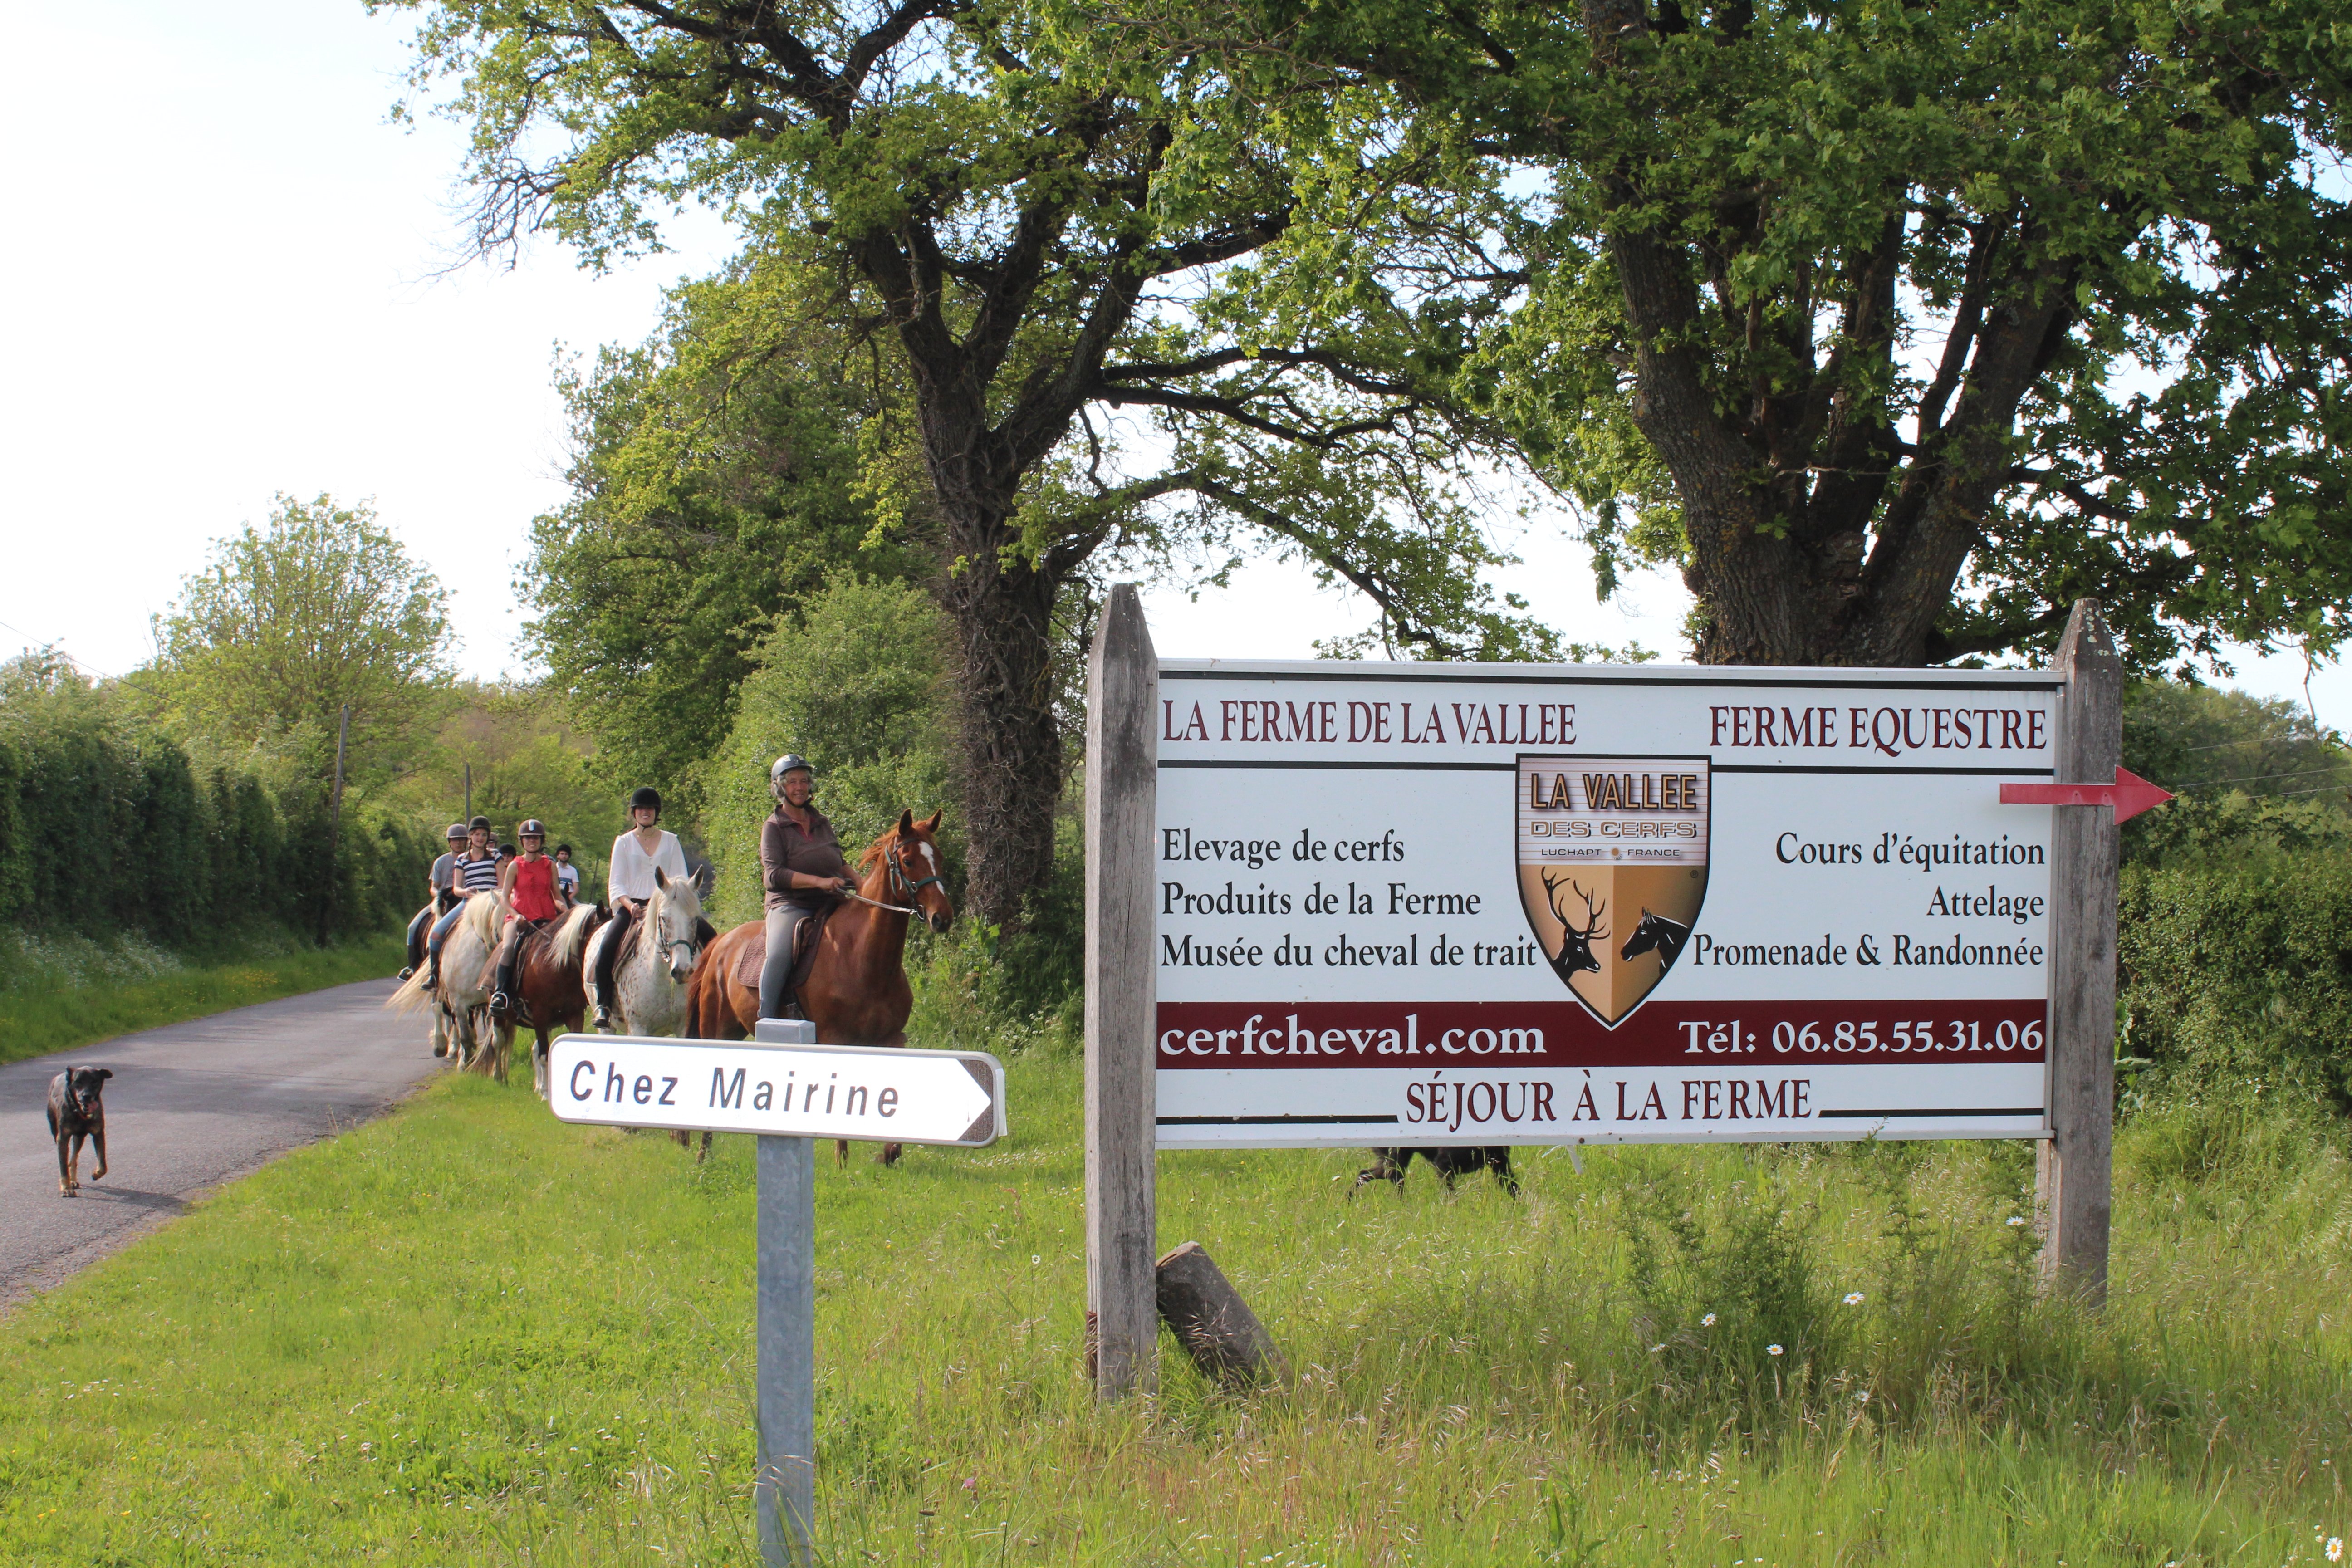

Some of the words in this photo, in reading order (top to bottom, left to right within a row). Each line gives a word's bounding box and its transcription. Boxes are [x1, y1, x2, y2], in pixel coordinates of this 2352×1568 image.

[1162, 699, 1210, 741] LA
[1220, 700, 1338, 743] FERME
[1347, 701, 1392, 743] DE
[1401, 702, 1447, 744] LA
[1451, 703, 1577, 745] VALLEE
[1709, 706, 1838, 747] FERME
[1848, 707, 2047, 757] EQUESTRE
[1531, 773, 1571, 809] LA
[1583, 774, 1697, 810] VALLEE
[1162, 828, 1281, 870] Elevage
[1292, 828, 1327, 862] de
[1334, 829, 1405, 862] cerfs
[1530, 821, 1591, 838] DES
[1600, 821, 1697, 838] CERFS
[1776, 832, 1862, 864] Cours
[1161, 881, 1291, 915] Produits
[1304, 882, 1338, 915] de
[1348, 882, 1374, 915] la
[1387, 882, 1481, 915] Ferme
[1926, 884, 2044, 925] Attelage
[1161, 934, 1263, 967] Musée
[1274, 933, 1313, 966] du
[1324, 933, 1418, 966] cheval
[1430, 933, 1464, 966] de
[1473, 934, 1537, 966] trait
[1693, 933, 1847, 965] Promenade
[1856, 934, 1881, 966] &
[1893, 933, 2043, 965] Randonnée
[1160, 1014, 1547, 1055] cerfcheval.com
[1678, 1019, 1756, 1053] Tél:
[1772, 1019, 2043, 1053] 06.85.55.31.06
[570, 1060, 678, 1106] Chez
[709, 1067, 899, 1118] Mairine
[1406, 1070, 1557, 1133] SÉJOUR
[1572, 1069, 1600, 1121] À
[1615, 1081, 1667, 1121] LA
[1681, 1079, 1812, 1120] FERME
